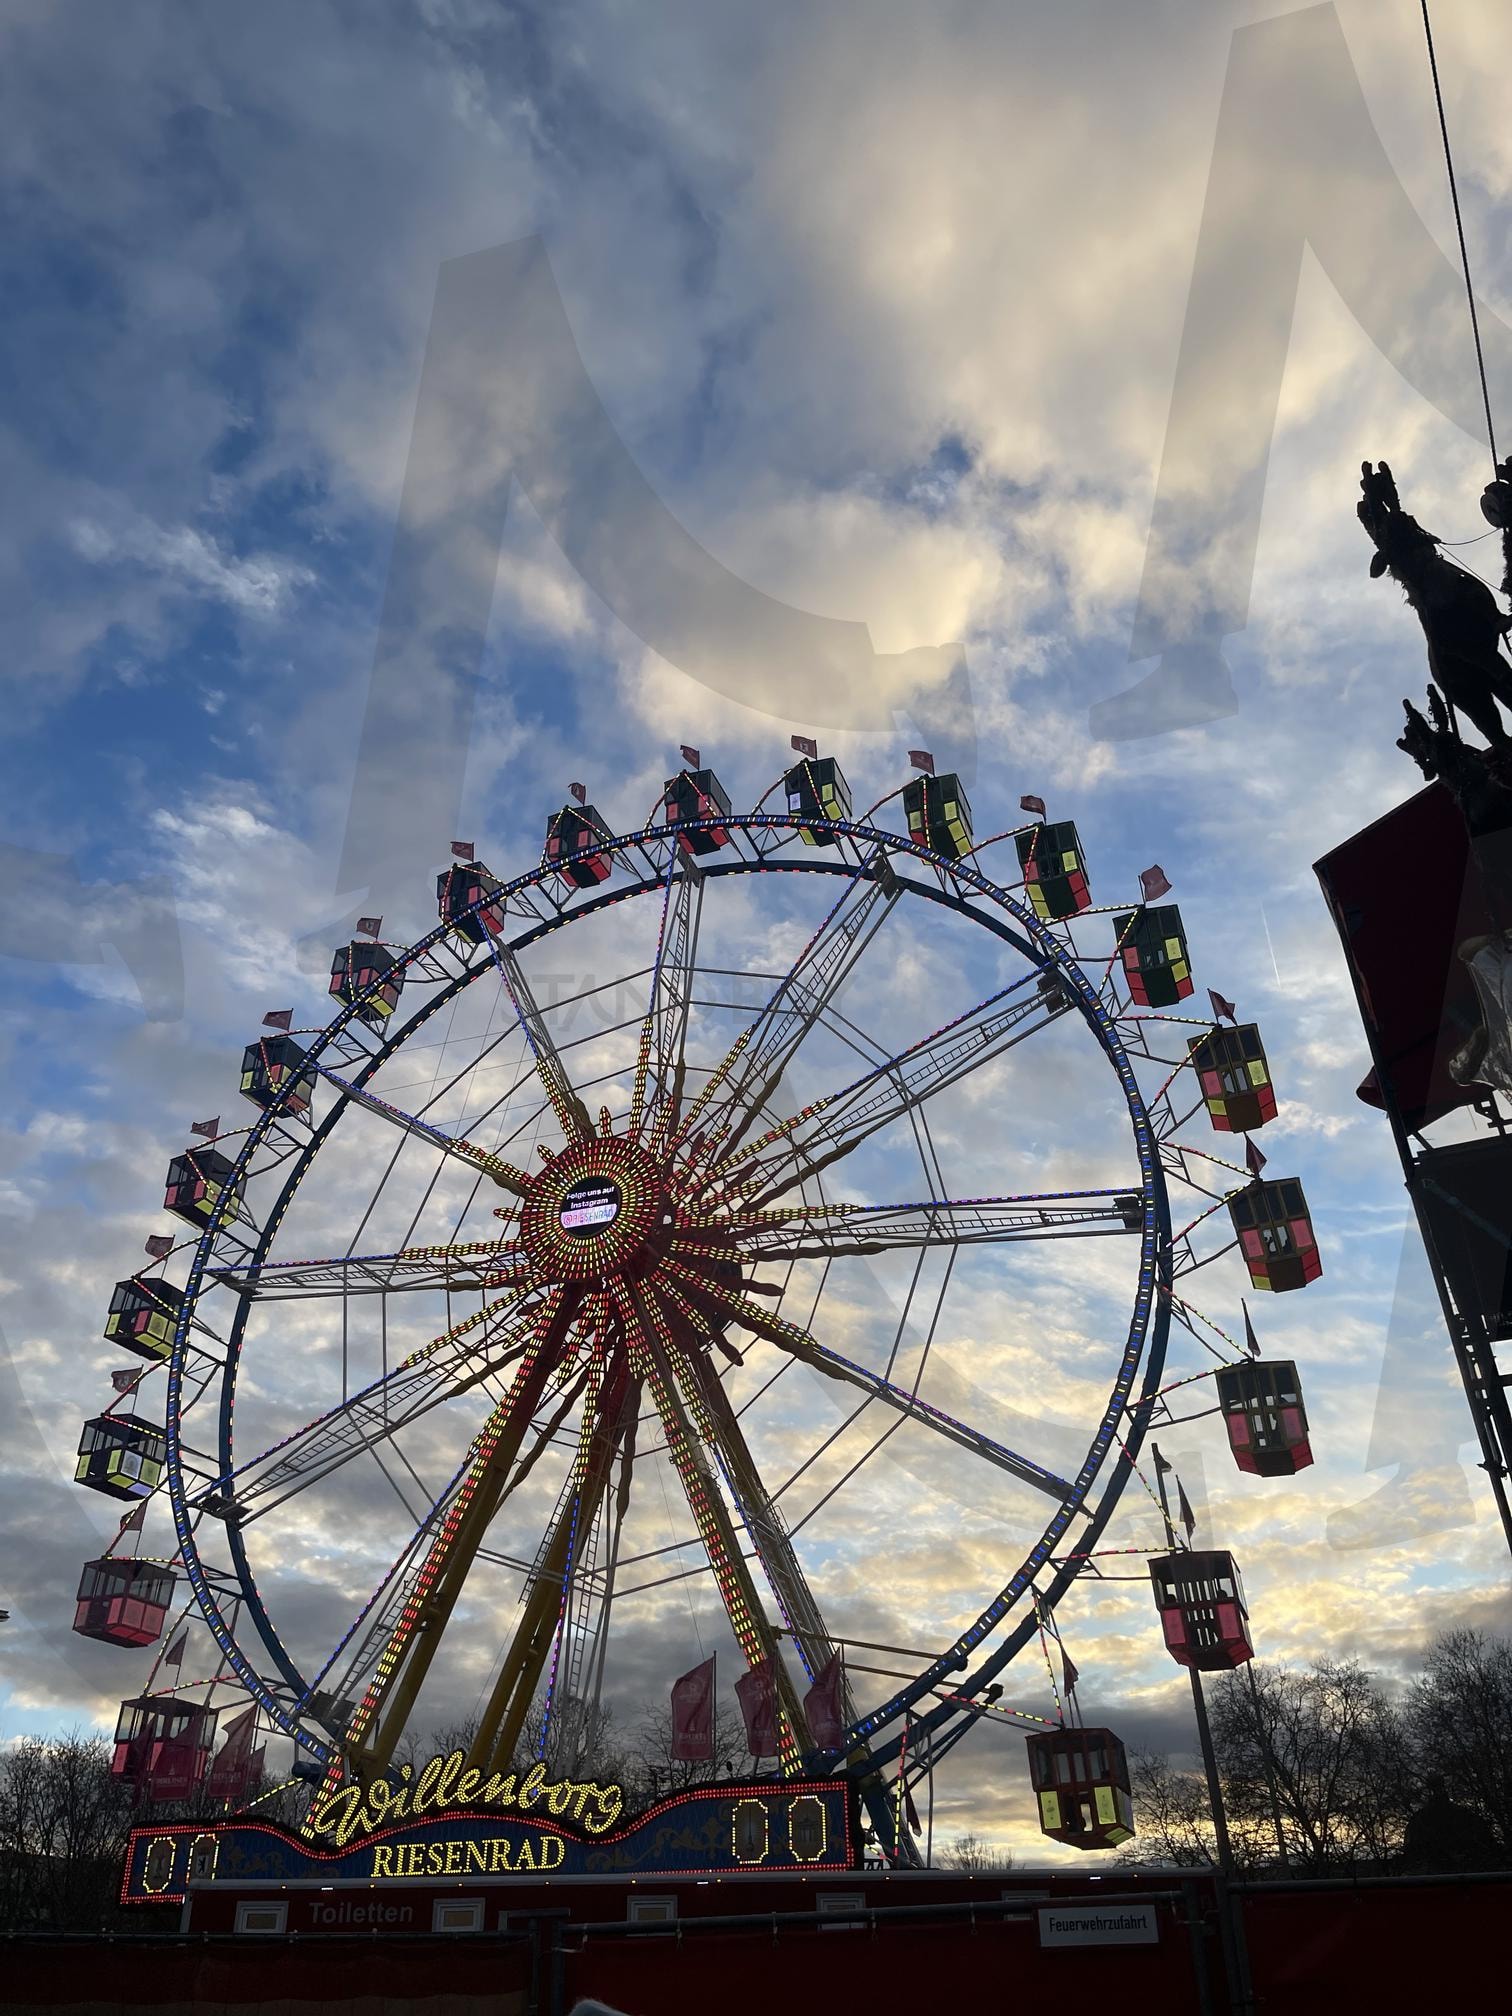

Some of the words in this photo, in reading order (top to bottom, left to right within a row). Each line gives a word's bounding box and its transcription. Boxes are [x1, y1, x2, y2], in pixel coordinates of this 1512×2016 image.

[602, 1186, 615, 1194] auf
[570, 1198, 609, 1209] Instagram
[313, 1750, 623, 1847] Willenborg
[370, 1835, 566, 1878] RIESENRAD
[308, 1901, 414, 1924] Toiletten
[1048, 1914, 1148, 1933] Feuerwehrzufahrt
